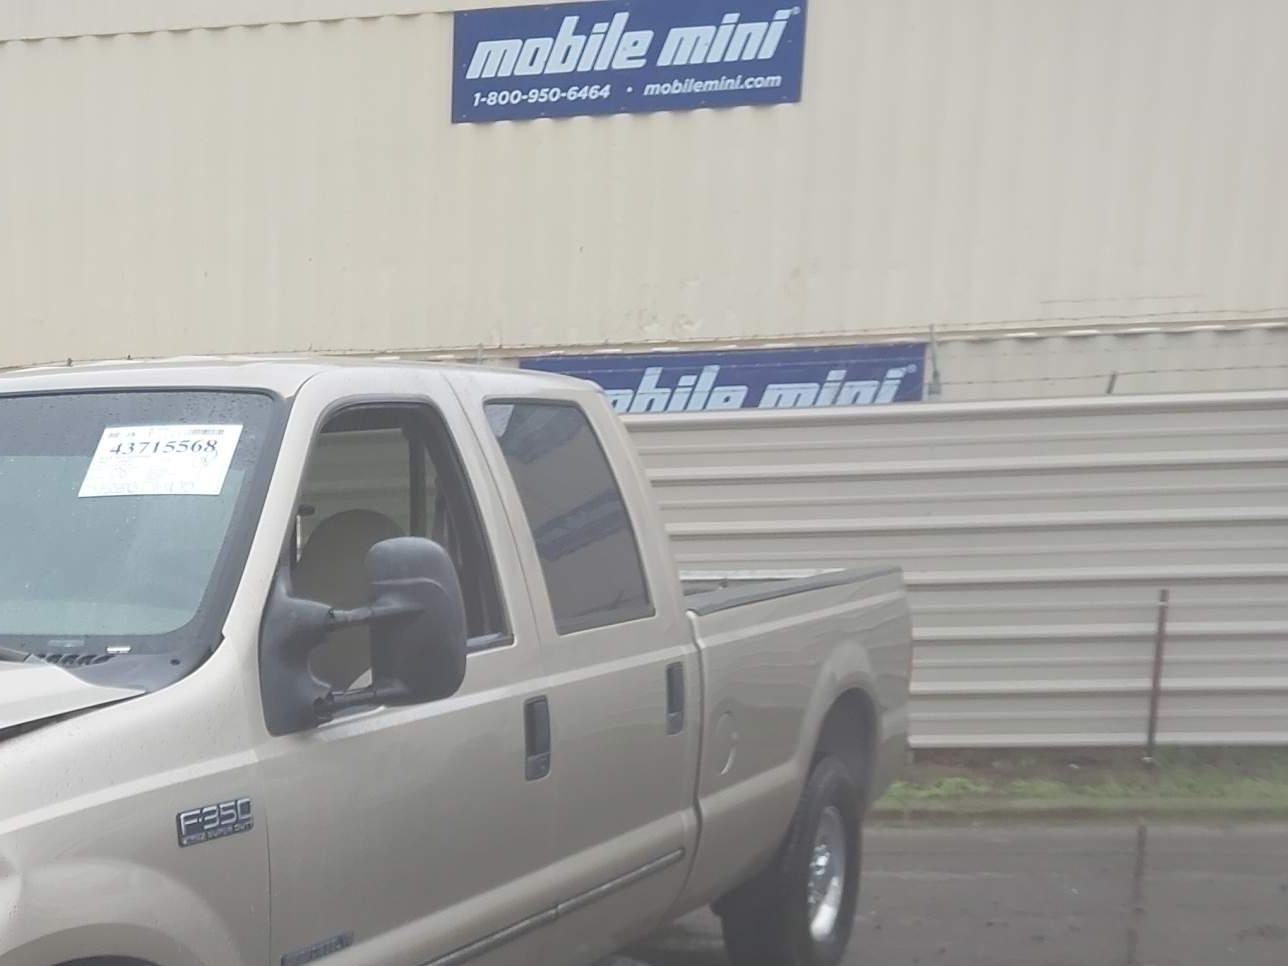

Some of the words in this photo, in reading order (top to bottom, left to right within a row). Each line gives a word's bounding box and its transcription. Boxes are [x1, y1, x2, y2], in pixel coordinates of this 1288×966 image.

[466, 12, 654, 79] mobile
[657, 10, 793, 66] mini
[473, 84, 611, 107] 1-800-950-6464
[644, 75, 782, 97] mobilemini.com
[760, 369, 905, 408] mini
[110, 439, 218, 455] 43715568
